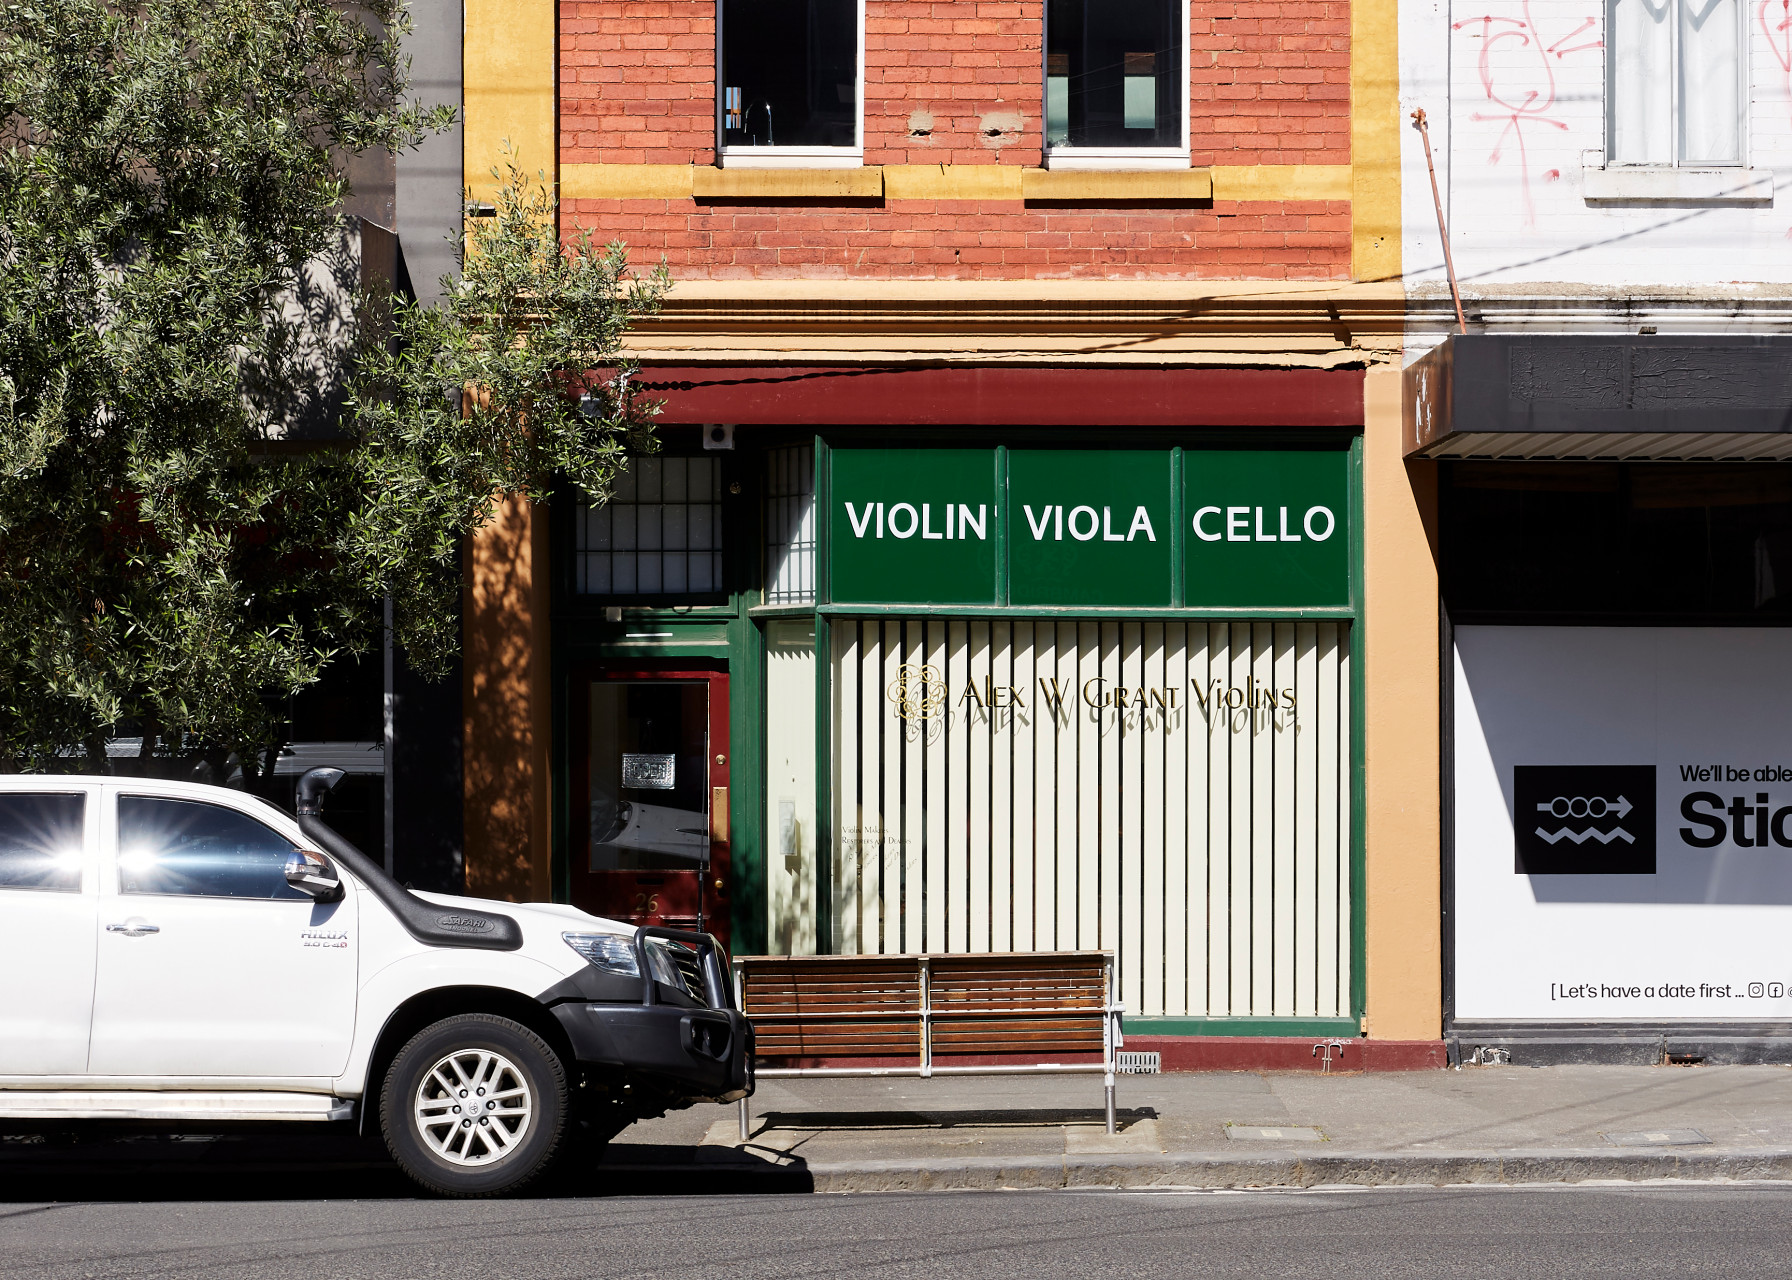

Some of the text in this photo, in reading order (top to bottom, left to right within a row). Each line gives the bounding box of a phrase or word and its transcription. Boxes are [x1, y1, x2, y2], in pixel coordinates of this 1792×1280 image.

[844, 502, 987, 540] VIOLIN
[1023, 505, 1157, 542] VIOLA
[1192, 506, 1336, 542] CELLO
[1039, 677, 1070, 709] W
[1726, 764, 1751, 782] be
[1753, 764, 1792, 782] able
[635, 893, 659, 912] 26
[443, 915, 487, 928] SAFARI
[301, 930, 348, 939] HILUX
[1600, 983, 1641, 999] have
[1644, 986, 1655, 999] a
[1658, 983, 1695, 999] date
[1700, 983, 1732, 999] first
